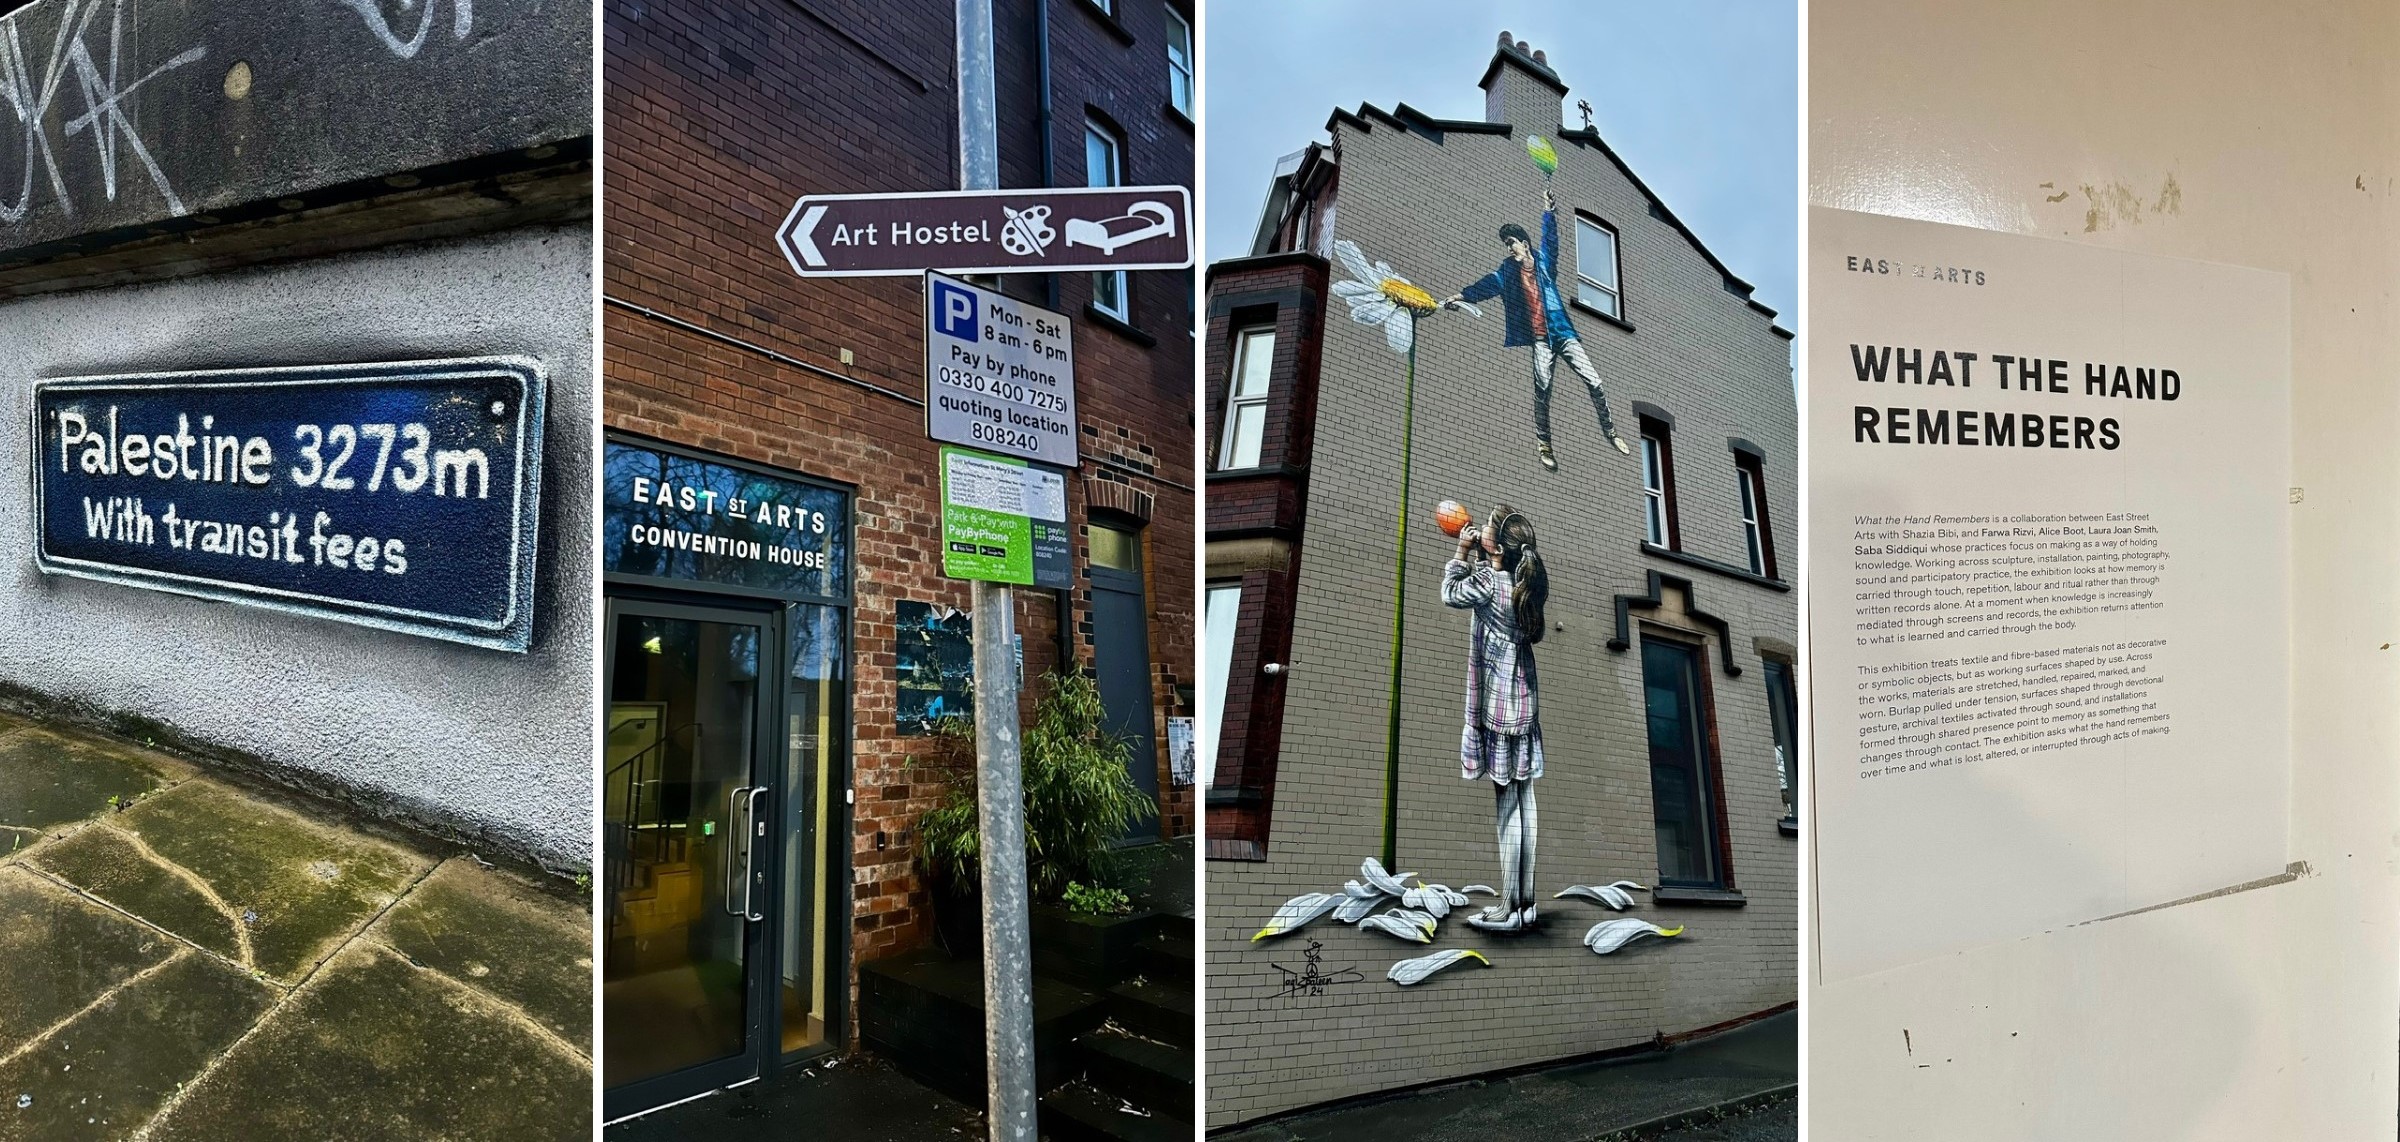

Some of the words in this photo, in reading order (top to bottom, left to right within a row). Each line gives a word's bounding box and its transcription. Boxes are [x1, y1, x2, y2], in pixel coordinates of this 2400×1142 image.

[831, 223, 878, 246] Art
[892, 220, 991, 246] Hostel
[1847, 256, 1903, 276] EAST
[1933, 266, 1986, 286] ARTS
[945, 290, 972, 332] P
[990, 304, 1023, 328] Mon
[1036, 319, 1061, 340] Sat
[984, 326, 994, 341] 8
[998, 332, 1020, 349] am
[1033, 339, 1042, 354] 6
[1046, 346, 1067, 362] pm
[952, 344, 980, 370] Pay
[986, 354, 1005, 376] by
[1010, 364, 1056, 387] phone
[1850, 344, 1978, 386] WHAT
[1992, 354, 2068, 393] THE
[2085, 362, 2180, 400] HAND
[939, 366, 985, 392] 0330
[990, 380, 1024, 402] 400
[939, 394, 1002, 423] quoting
[1008, 408, 1068, 436] location
[1854, 406, 2120, 450] REMEMBERS
[59, 405, 273, 484] Palestine
[291, 423, 490, 499] 3273m
[972, 422, 1038, 450] 808240
[633, 476, 718, 514] EAST
[728, 497, 748, 516] ST
[756, 501, 825, 534] ARTS
[947, 509, 968, 522] Park
[980, 515, 996, 528] Pay
[1854, 515, 1882, 525] What
[1885, 515, 1901, 525] the
[1903, 515, 1932, 524] Hand
[1933, 514, 1990, 524] Remembers
[1992, 515, 2000, 523] is
[2010, 514, 2066, 523] collaboration
[2068, 514, 2104, 522] between
[2106, 512, 2124, 522] East
[2126, 512, 2150, 521] Street
[84, 496, 154, 546] With
[162, 502, 305, 564] transit
[310, 511, 408, 575] fees
[631, 524, 760, 560] CONVENTION
[768, 544, 824, 569] HOUSE
[948, 525, 1009, 542] PayByPhone
[1854, 530, 1876, 540] Arts
[1878, 530, 1900, 539] with
[1902, 529, 1936, 539] Shazia
[1938, 528, 1959, 539] Bibi,
[1961, 528, 1979, 538] and
[1981, 528, 2010, 537] Farwa
[2012, 527, 2036, 537] Rizvi,
[2038, 527, 2061, 536] Alice
[2063, 526, 2086, 536] Boot,
[2088, 526, 2112, 535] Laura
[2113, 526, 2132, 534] Joan
[2134, 525, 2158, 534] Smith,
[1854, 545, 1883, 556] Saba
[1886, 544, 1928, 556] Siddiqui
[1930, 543, 1962, 553] whose
[1964, 542, 2007, 554] practices
[2009, 541, 2034, 551] focus
[2050, 540, 2081, 551] making
[2101, 540, 2118, 550] way
[2119, 538, 2128, 547] of
[2130, 538, 2158, 548] holding
[1855, 560, 1912, 571] knowledge.
[1914, 558, 1956, 569] Working
[1958, 558, 1990, 567] across
[1992, 555, 2036, 566] sculpture,
[2037, 554, 2084, 563] installation,
[2086, 552, 2120, 563] painting,
[1855, 574, 1887, 585] sound
[1889, 574, 1908, 584] and
[1911, 572, 1971, 585] participatory
[1973, 570, 2012, 582] practice,
[2014, 568, 2028, 578] the
[2030, 567, 2072, 577] exhibition
[2074, 566, 2096, 575] looks
[2098, 565, 2106, 574] at
[2108, 565, 2124, 573] how
[2126, 564, 2157, 573] memory
[1857, 665, 1879, 675] This
[1881, 661, 1928, 673] exhibition
[1930, 658, 1959, 668] treats
[1961, 655, 1989, 666] textile
[1991, 652, 2008, 663] and
[2010, 647, 2060, 660] fibre-based
[2062, 644, 2100, 655] materials
[2101, 643, 2115, 652] not
[2128, 639, 2167, 649] decorative
[1872, 676, 1915, 691] symbolic
[1917, 673, 1954, 686] objects,
[1956, 670, 1972, 680] but
[1987, 666, 2024, 676] working
[2025, 662, 2062, 673] surfaces
[2064, 656, 2095, 669] shaped
[2096, 657, 2106, 667] by
[2108, 656, 2125, 664] use.
[2126, 653, 2153, 662] Across
[1858, 695, 1875, 705] the
[1877, 691, 1910, 703] works,
[1912, 686, 1956, 699] materials
[1958, 685, 1974, 694] are
[1976, 678, 2020, 692] stretched,
[2022, 674, 2058, 686] handled,
[2060, 670, 2096, 683] repaired,
[2098, 666, 2130, 677] marked,
[2131, 665, 2146, 674] and
[1858, 710, 1886, 720] worn.
[1888, 705, 1921, 716] Burlap
[1923, 700, 1952, 715] pulled
[1954, 697, 1982, 709] under
[1984, 693, 2019, 705] tension,
[2021, 688, 2058, 700] surfaces
[2060, 683, 2091, 695] shaped
[2092, 679, 2124, 691] through
[2125, 675, 2164, 687] devotional
[1310, 987, 1323, 996] 24
